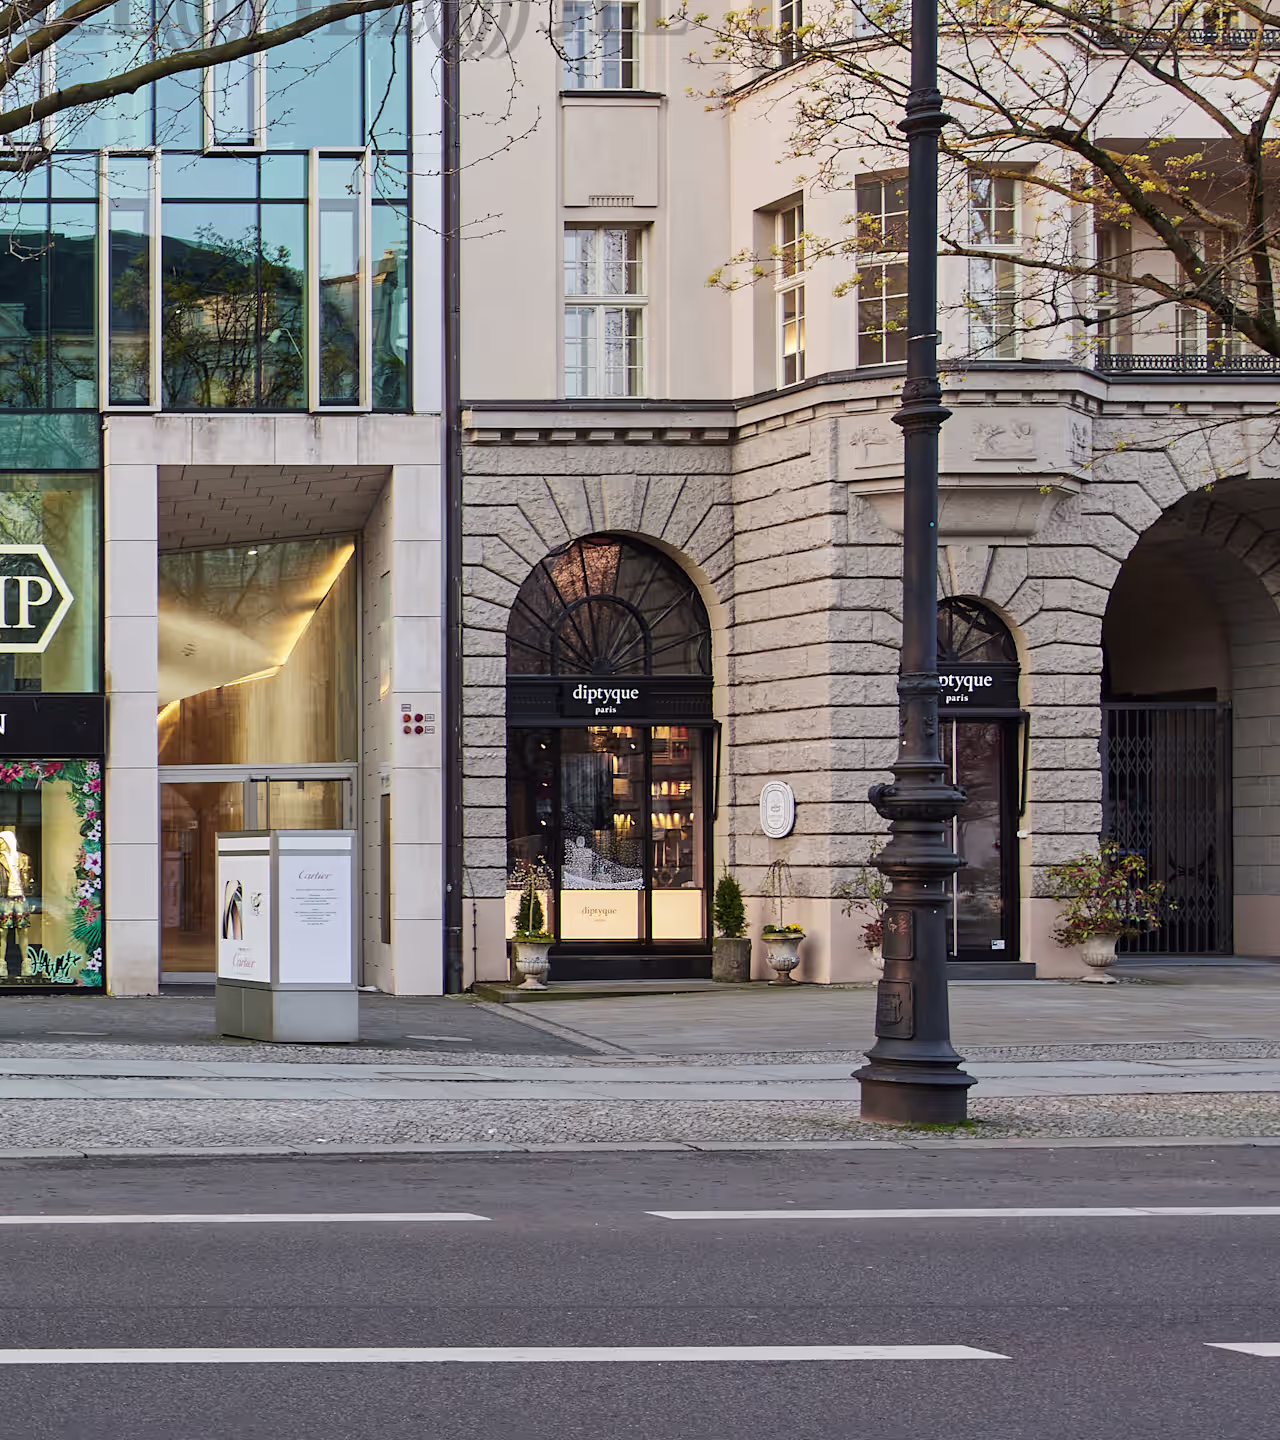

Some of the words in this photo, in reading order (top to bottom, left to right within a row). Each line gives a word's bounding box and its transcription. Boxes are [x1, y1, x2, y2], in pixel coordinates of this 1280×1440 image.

[938, 674, 993, 692] ptyque
[573, 684, 639, 704] diptyque
[945, 694, 969, 704] paris
[595, 706, 616, 715] paris
[298, 870, 333, 880] Cartier
[581, 906, 618, 916] diptyque
